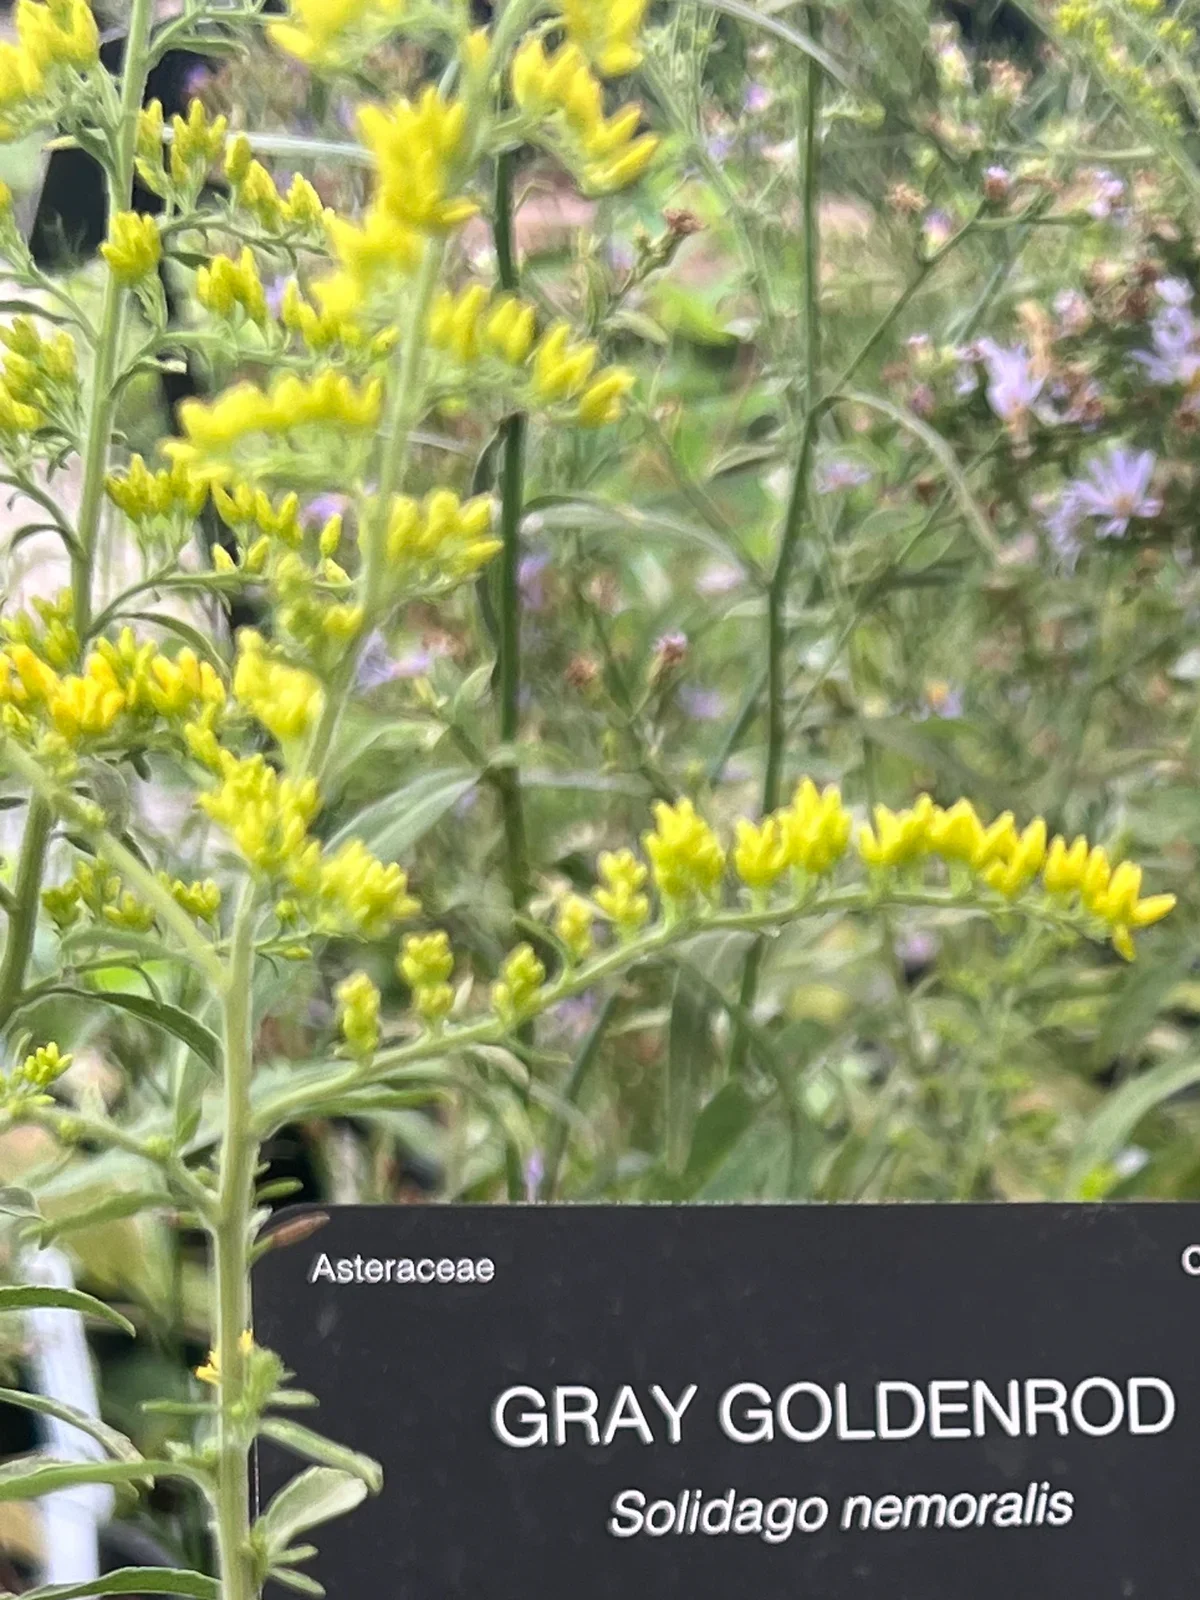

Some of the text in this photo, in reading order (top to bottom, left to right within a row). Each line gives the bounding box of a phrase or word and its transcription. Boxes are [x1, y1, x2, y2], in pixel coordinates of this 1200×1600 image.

[311, 1253, 496, 1284] Asteraceae
[492, 1376, 1176, 1448] GRAY GOLDENROD
[609, 1481, 1075, 1544] Solidago nemoralis
